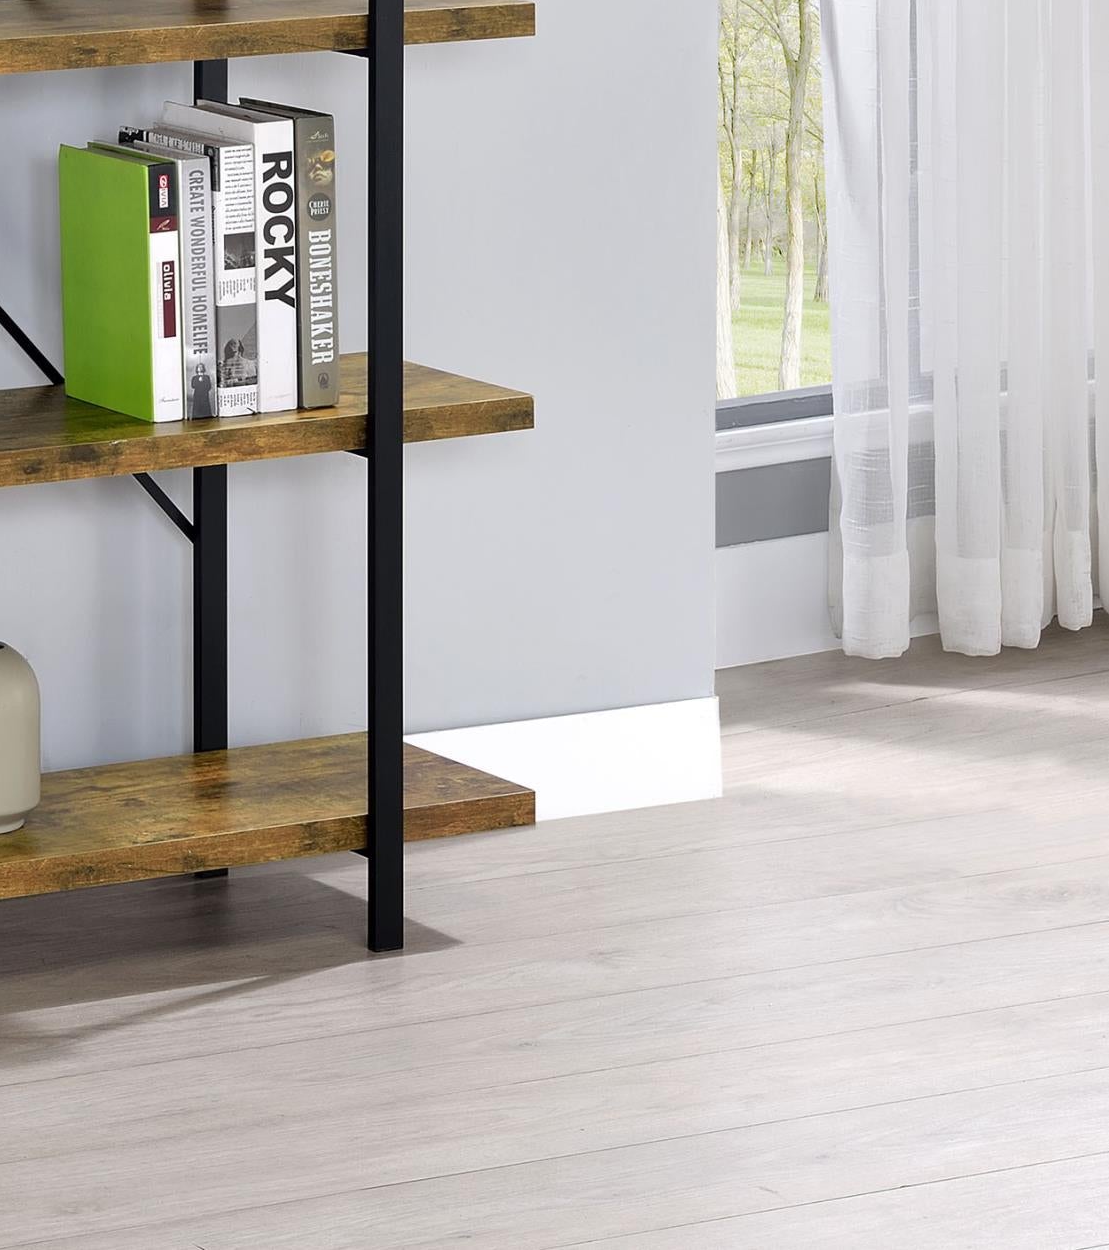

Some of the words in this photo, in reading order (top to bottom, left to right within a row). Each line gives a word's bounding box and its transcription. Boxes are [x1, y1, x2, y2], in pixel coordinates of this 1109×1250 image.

[189, 169, 205, 213] CREATE
[190, 214, 207, 291] WONDERFUL
[262, 150, 296, 310] ROCKY
[163, 263, 173, 301] olivia
[308, 228, 335, 366] BONESHAKER
[192, 296, 209, 355] HOMELIFE
